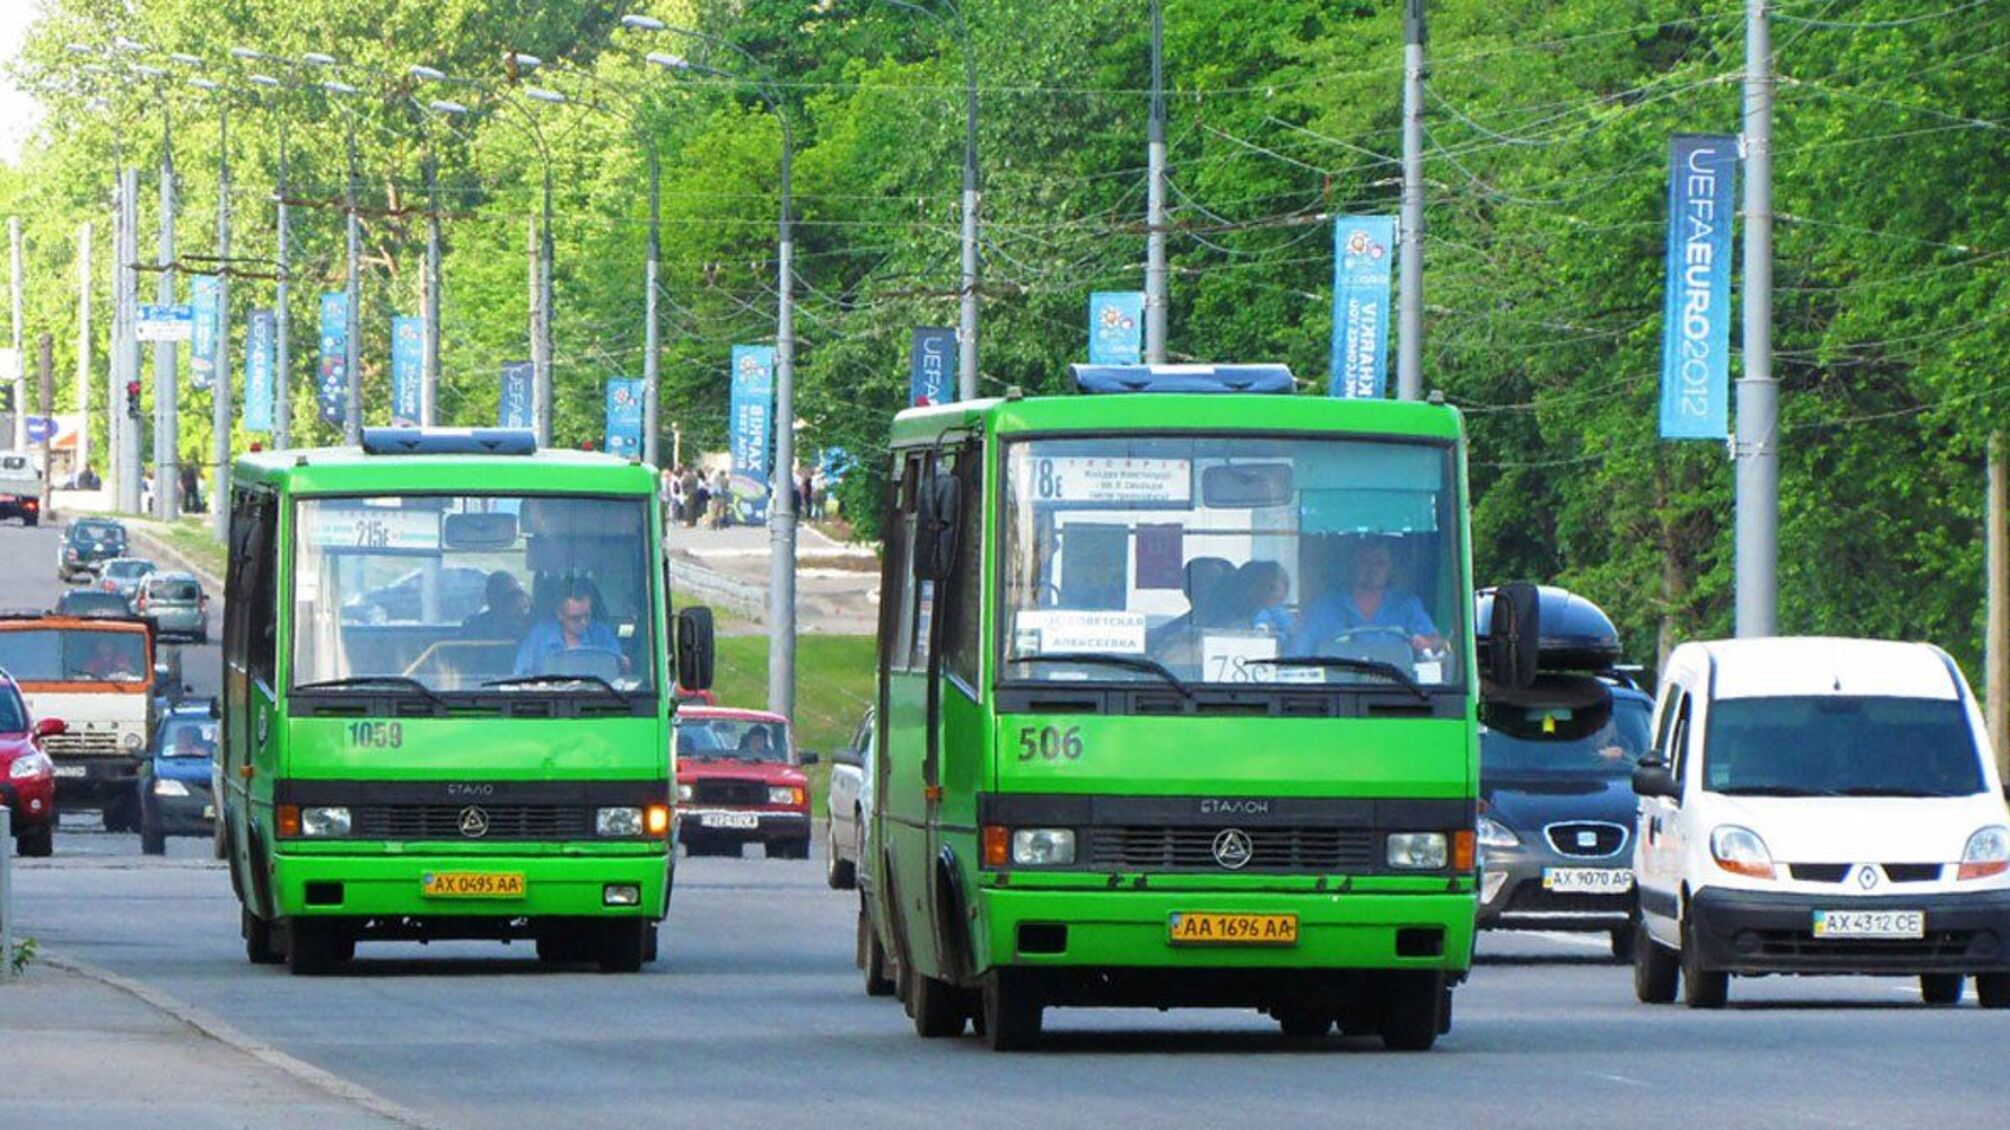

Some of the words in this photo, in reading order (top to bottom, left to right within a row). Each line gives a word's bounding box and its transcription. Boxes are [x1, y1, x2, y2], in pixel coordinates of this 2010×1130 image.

[349, 721, 403, 749] 1059
[1018, 725, 1084, 762] 506
[435, 877, 456, 892] AX
[459, 876, 494, 892] 0495
[497, 878, 520, 892] AA
[1183, 918, 1213, 937] AA
[1217, 918, 1260, 937] 1696
[1264, 919, 1293, 938] AA
[1826, 915, 1851, 931] AX
